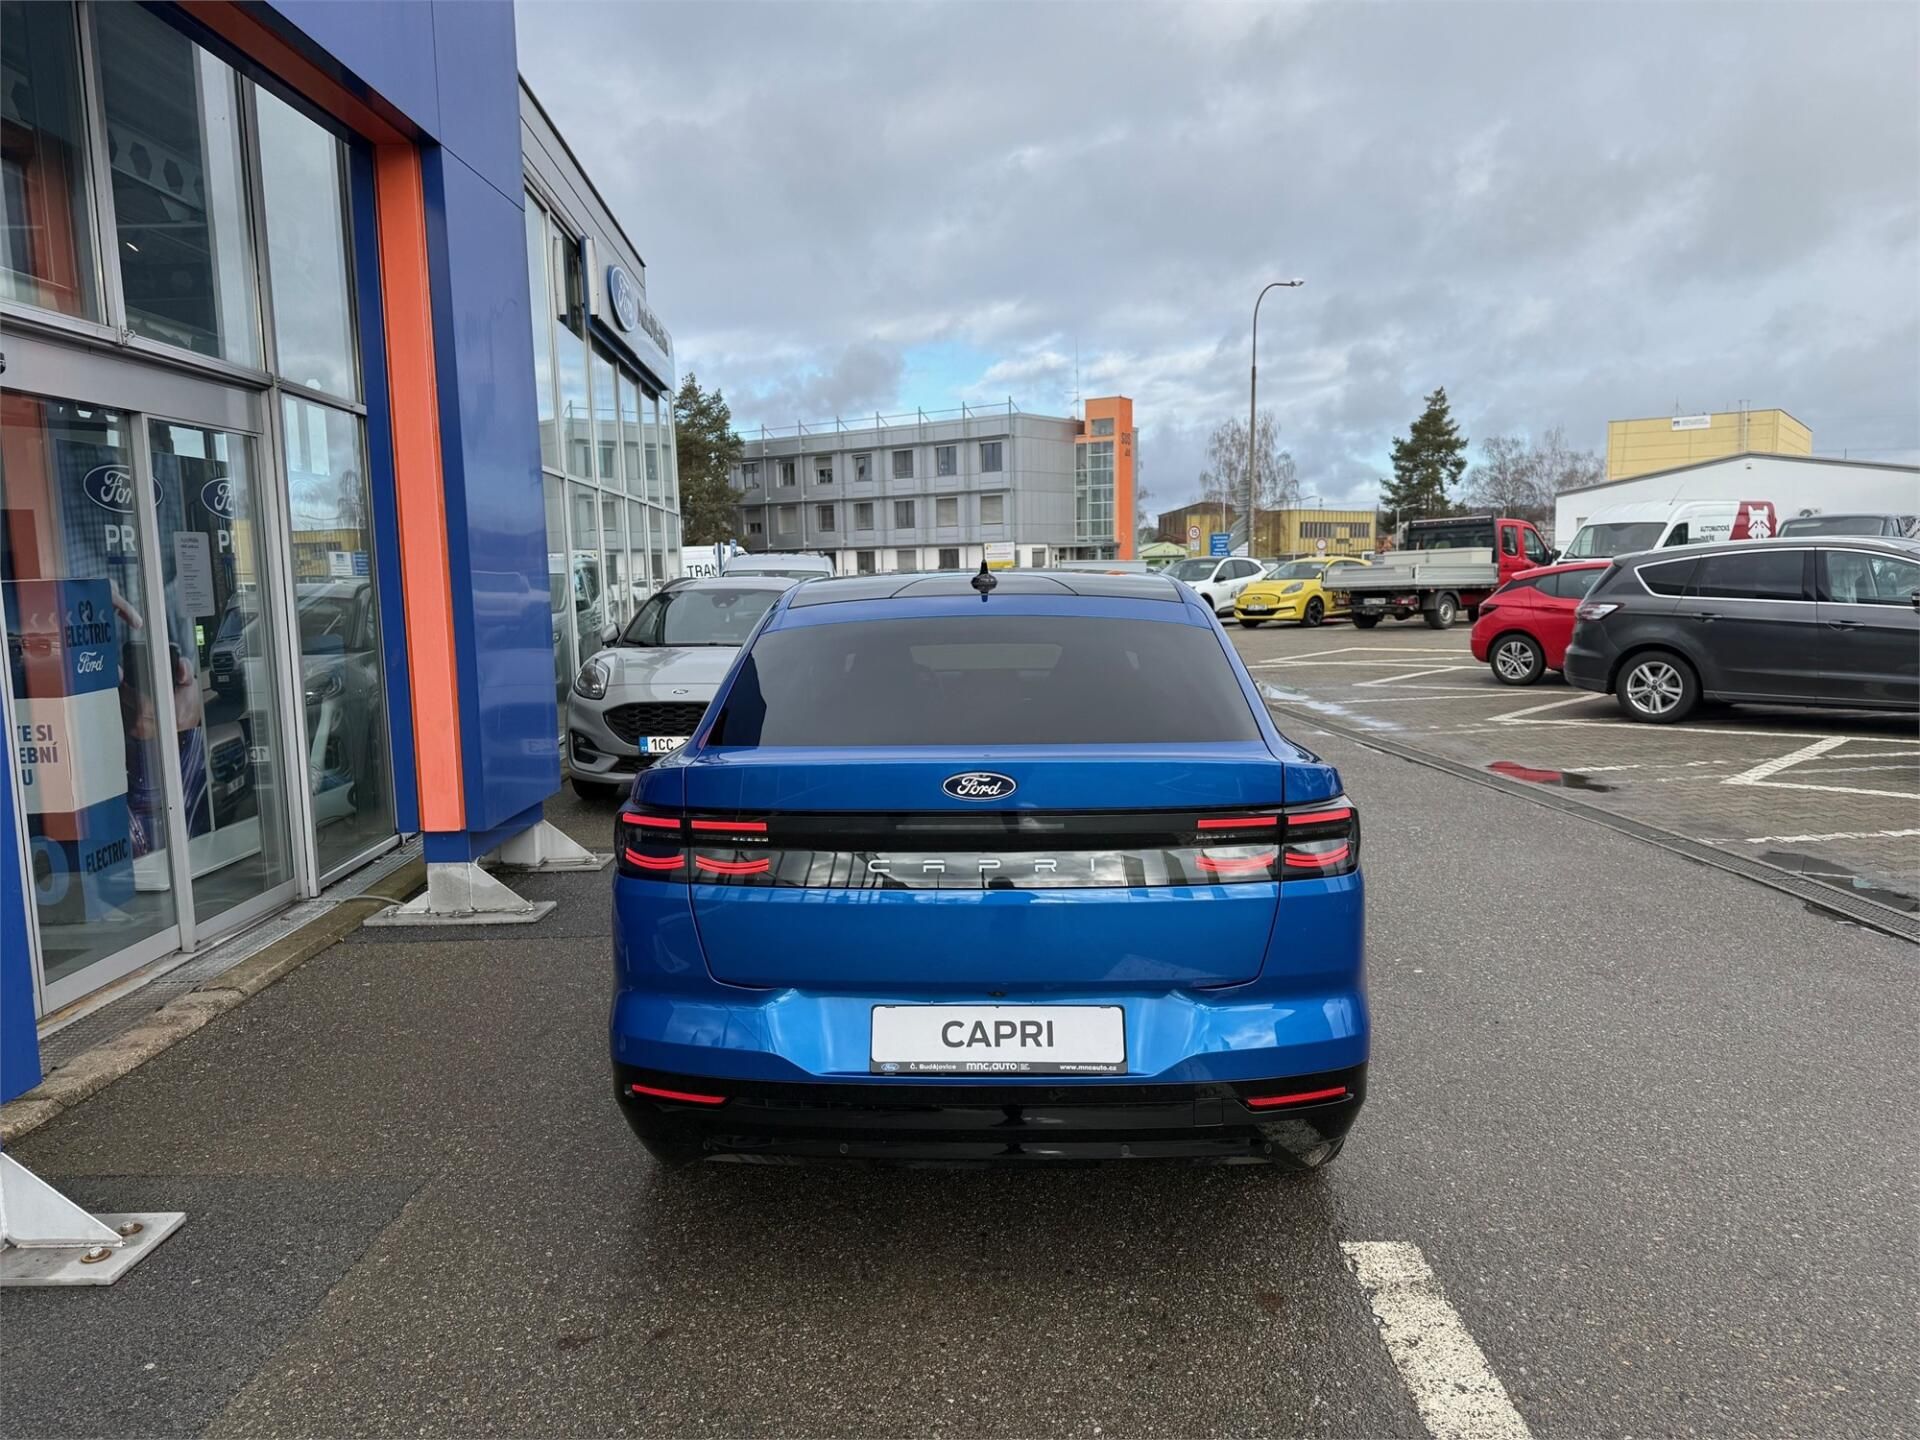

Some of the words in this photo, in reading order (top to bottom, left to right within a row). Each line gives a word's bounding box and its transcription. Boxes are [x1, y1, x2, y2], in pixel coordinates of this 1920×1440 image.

[65, 623, 112, 647] ELECTRIC
[77, 651, 104, 674] Ford
[36, 724, 54, 741] SI
[956, 777, 1001, 795] Ford
[86, 838, 129, 876] ELECTRIC
[868, 859, 1095, 873] CAPRI
[941, 1020, 1054, 1048] CAPRI
[1059, 1064, 1117, 1072] www.mncauto.cz
